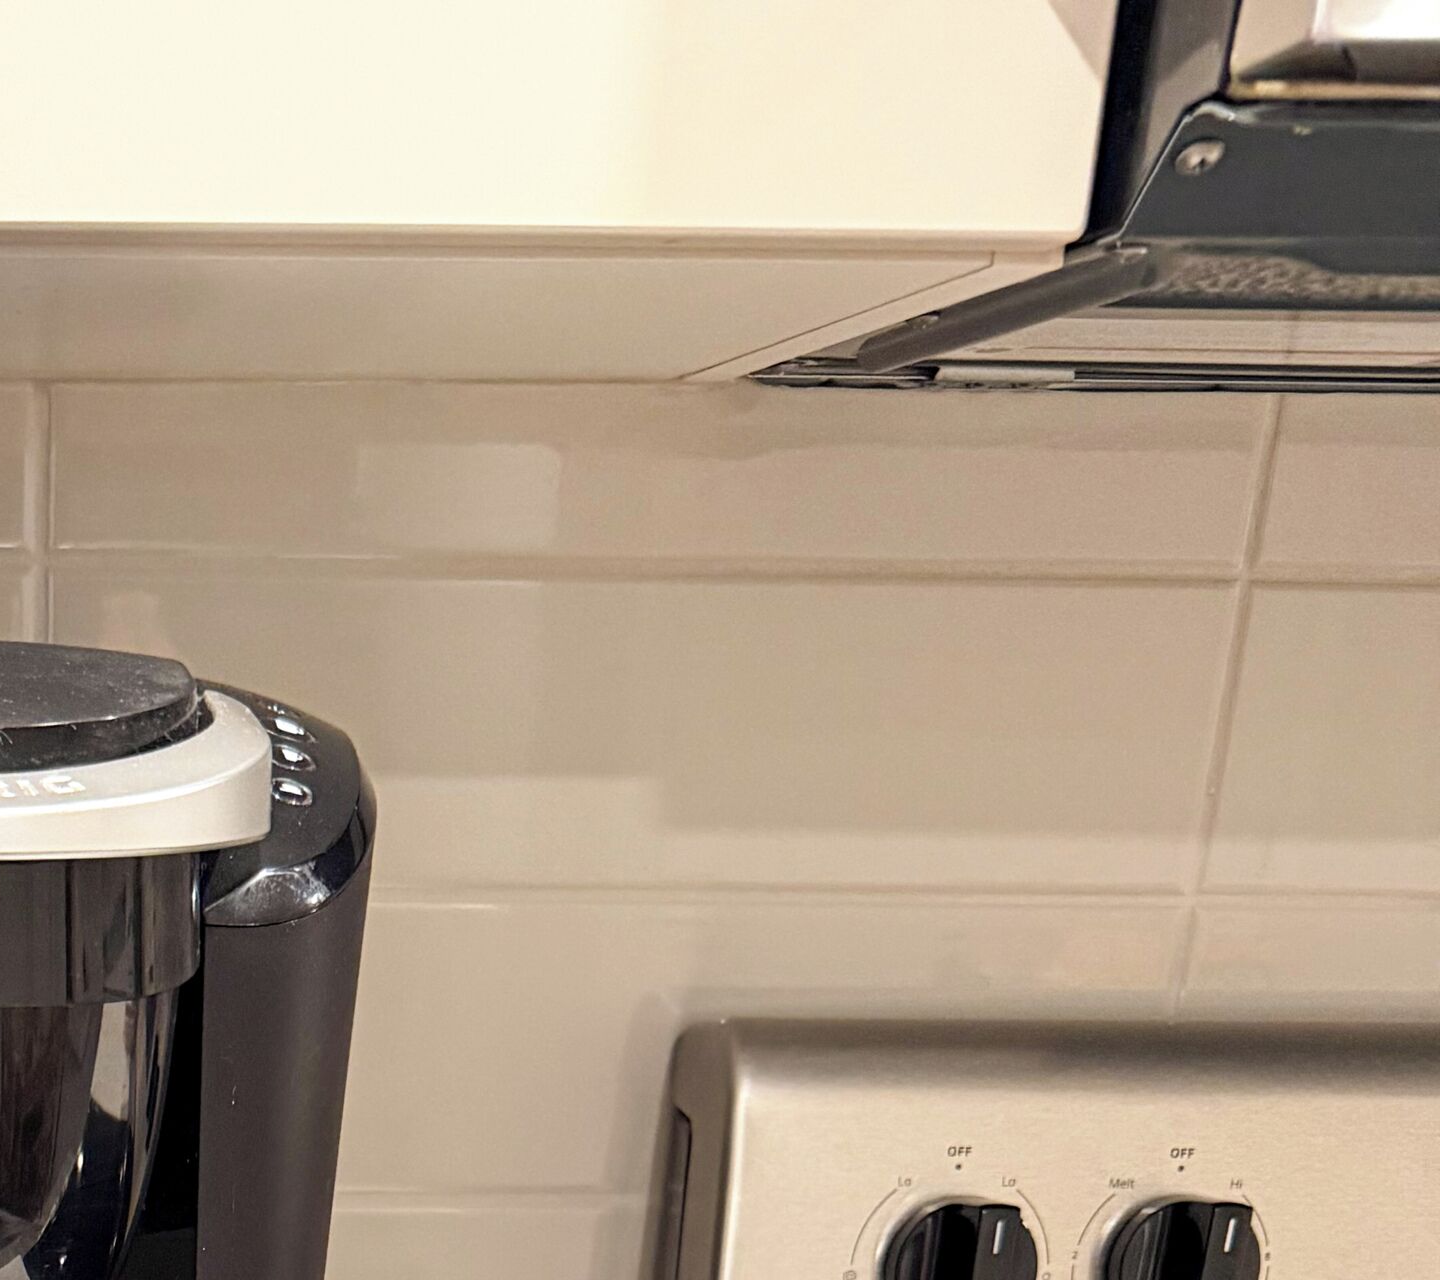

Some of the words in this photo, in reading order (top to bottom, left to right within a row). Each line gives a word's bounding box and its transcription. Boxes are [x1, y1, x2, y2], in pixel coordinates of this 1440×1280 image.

[947, 1146, 972, 1157] OFF
[1170, 1148, 1195, 1159] OFF
[1108, 1178, 1135, 1189] Melt
[1229, 1178, 1243, 1189] Hi
